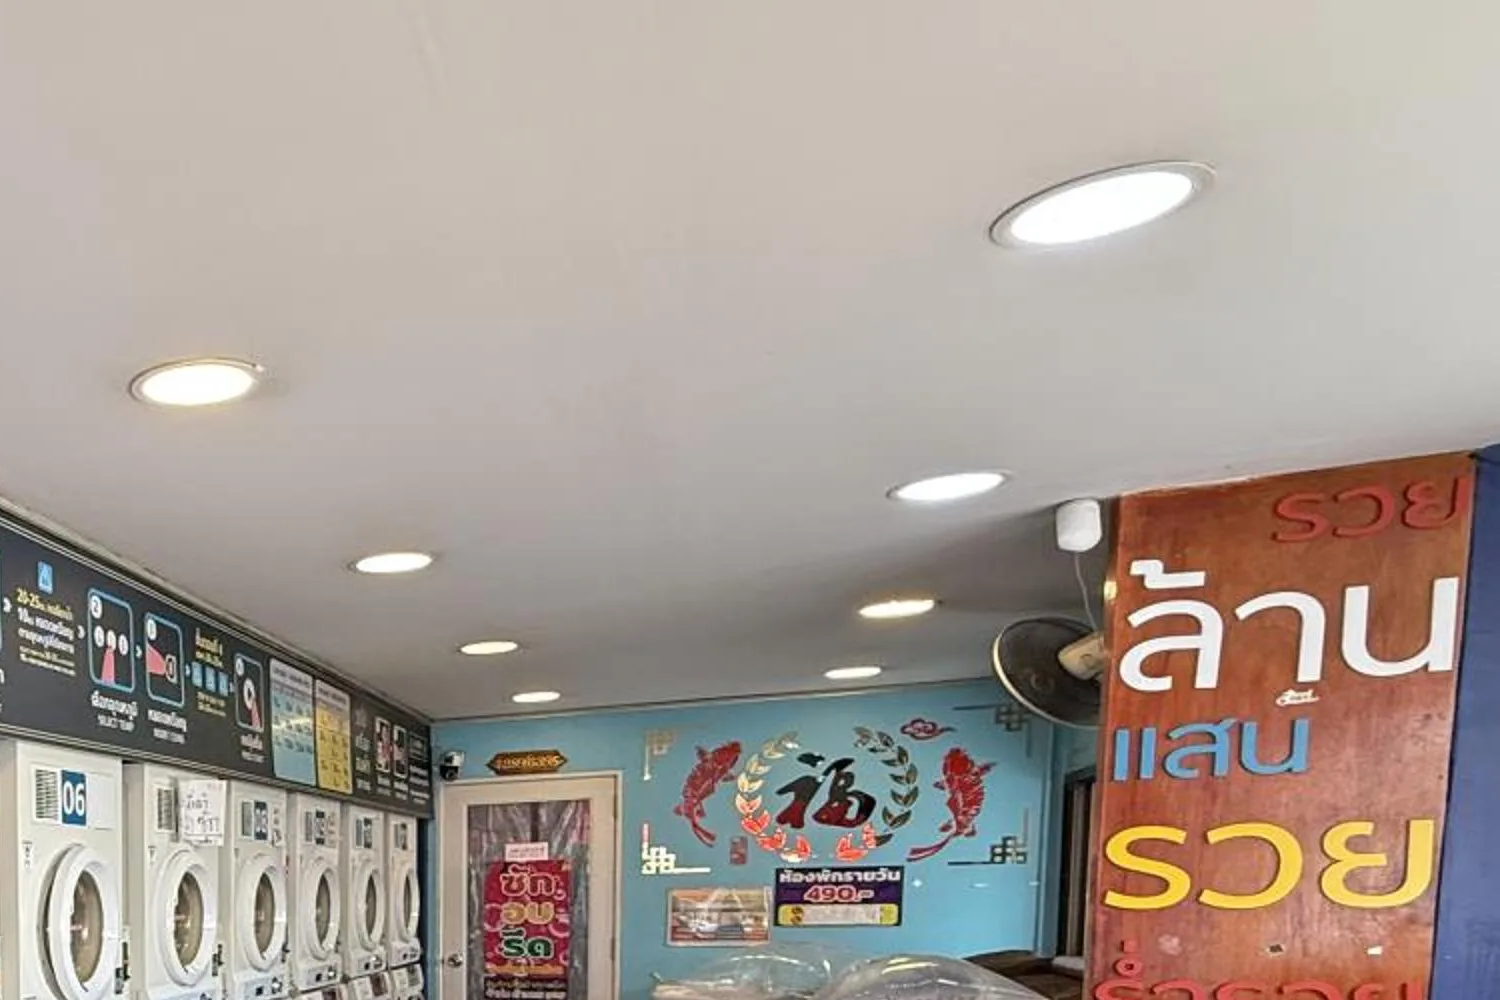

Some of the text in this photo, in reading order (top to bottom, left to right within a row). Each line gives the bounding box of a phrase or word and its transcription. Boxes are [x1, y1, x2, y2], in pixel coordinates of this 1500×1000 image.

[1273, 475, 1469, 542] รวย
[1118, 558, 1460, 693] ล้าน
[1112, 716, 1311, 782] แสน
[63, 780, 86, 816] 06
[500, 864, 555, 897] ซัก
[1103, 818, 1436, 910] รวย
[500, 901, 555, 925] อบ
